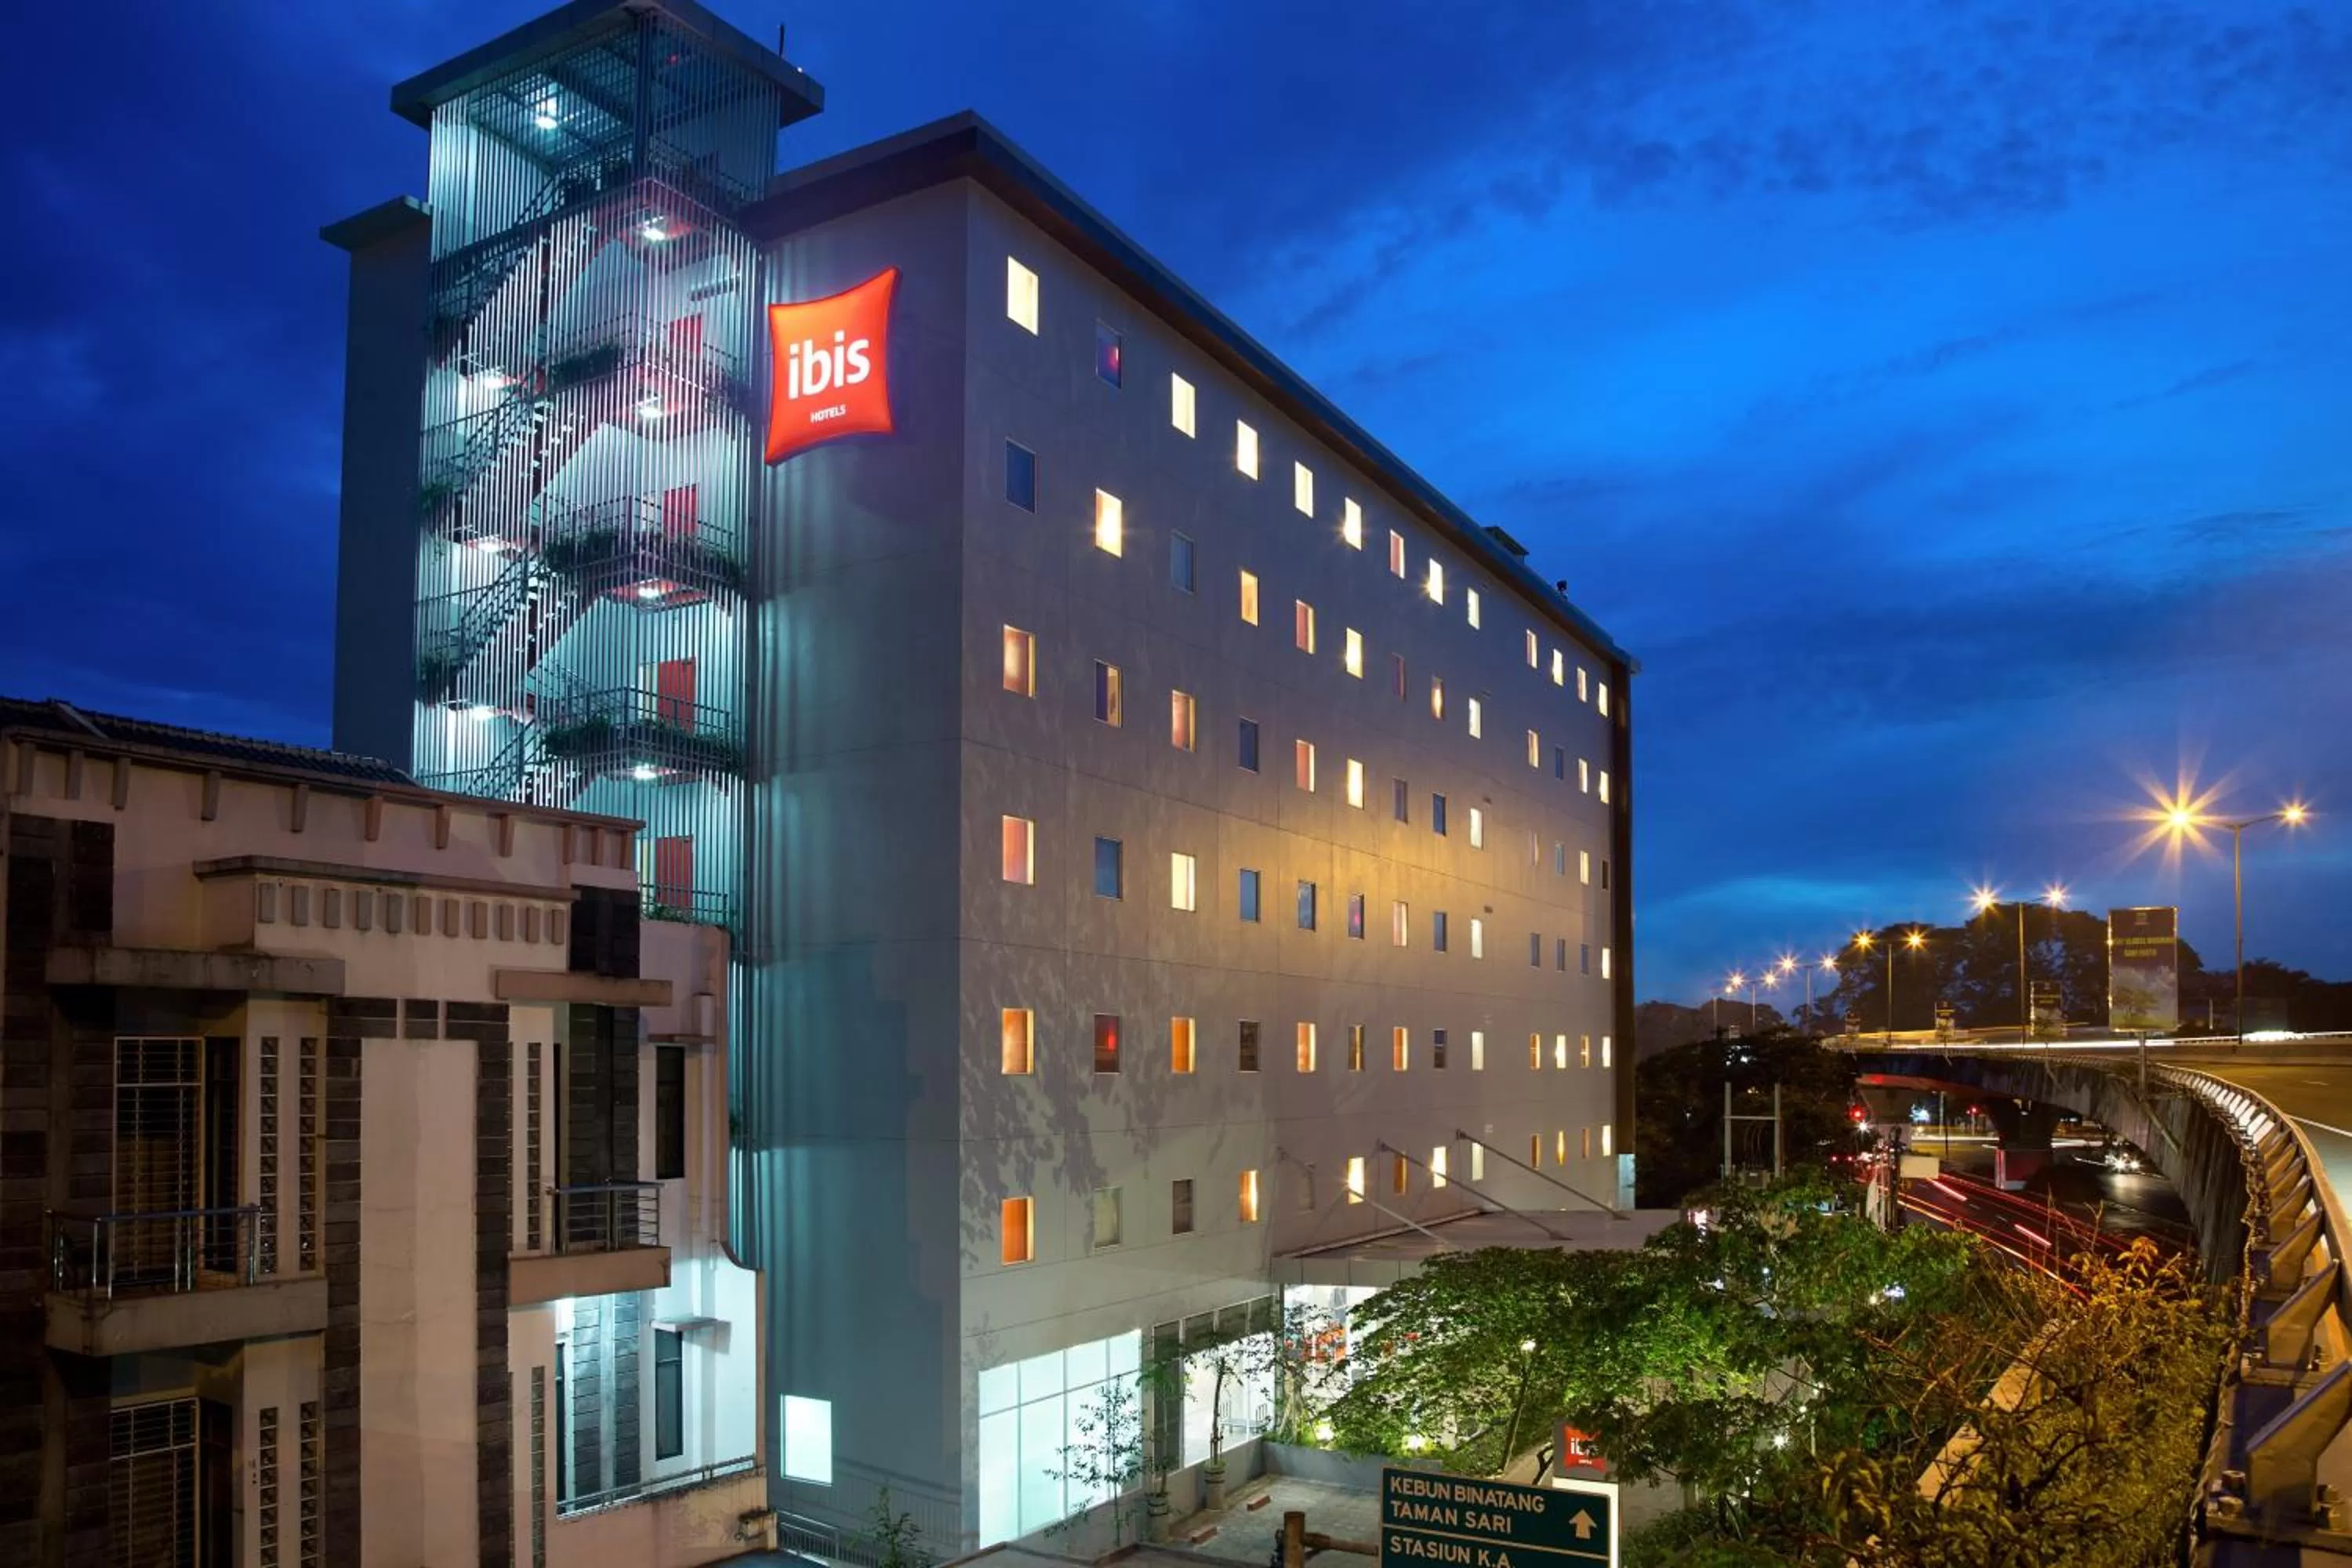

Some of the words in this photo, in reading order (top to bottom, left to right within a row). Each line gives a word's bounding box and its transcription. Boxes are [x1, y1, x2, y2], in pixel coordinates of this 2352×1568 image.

[789, 330, 870, 399] ibis
[811, 405, 846, 423] HOTELS
[1390, 1476, 1450, 1501] KEBUN
[1454, 1486, 1545, 1513] BINATANG
[1391, 1501, 1457, 1526] TAMAN
[1465, 1511, 1512, 1534] SARI
[1389, 1535, 1471, 1563] STASIUN
